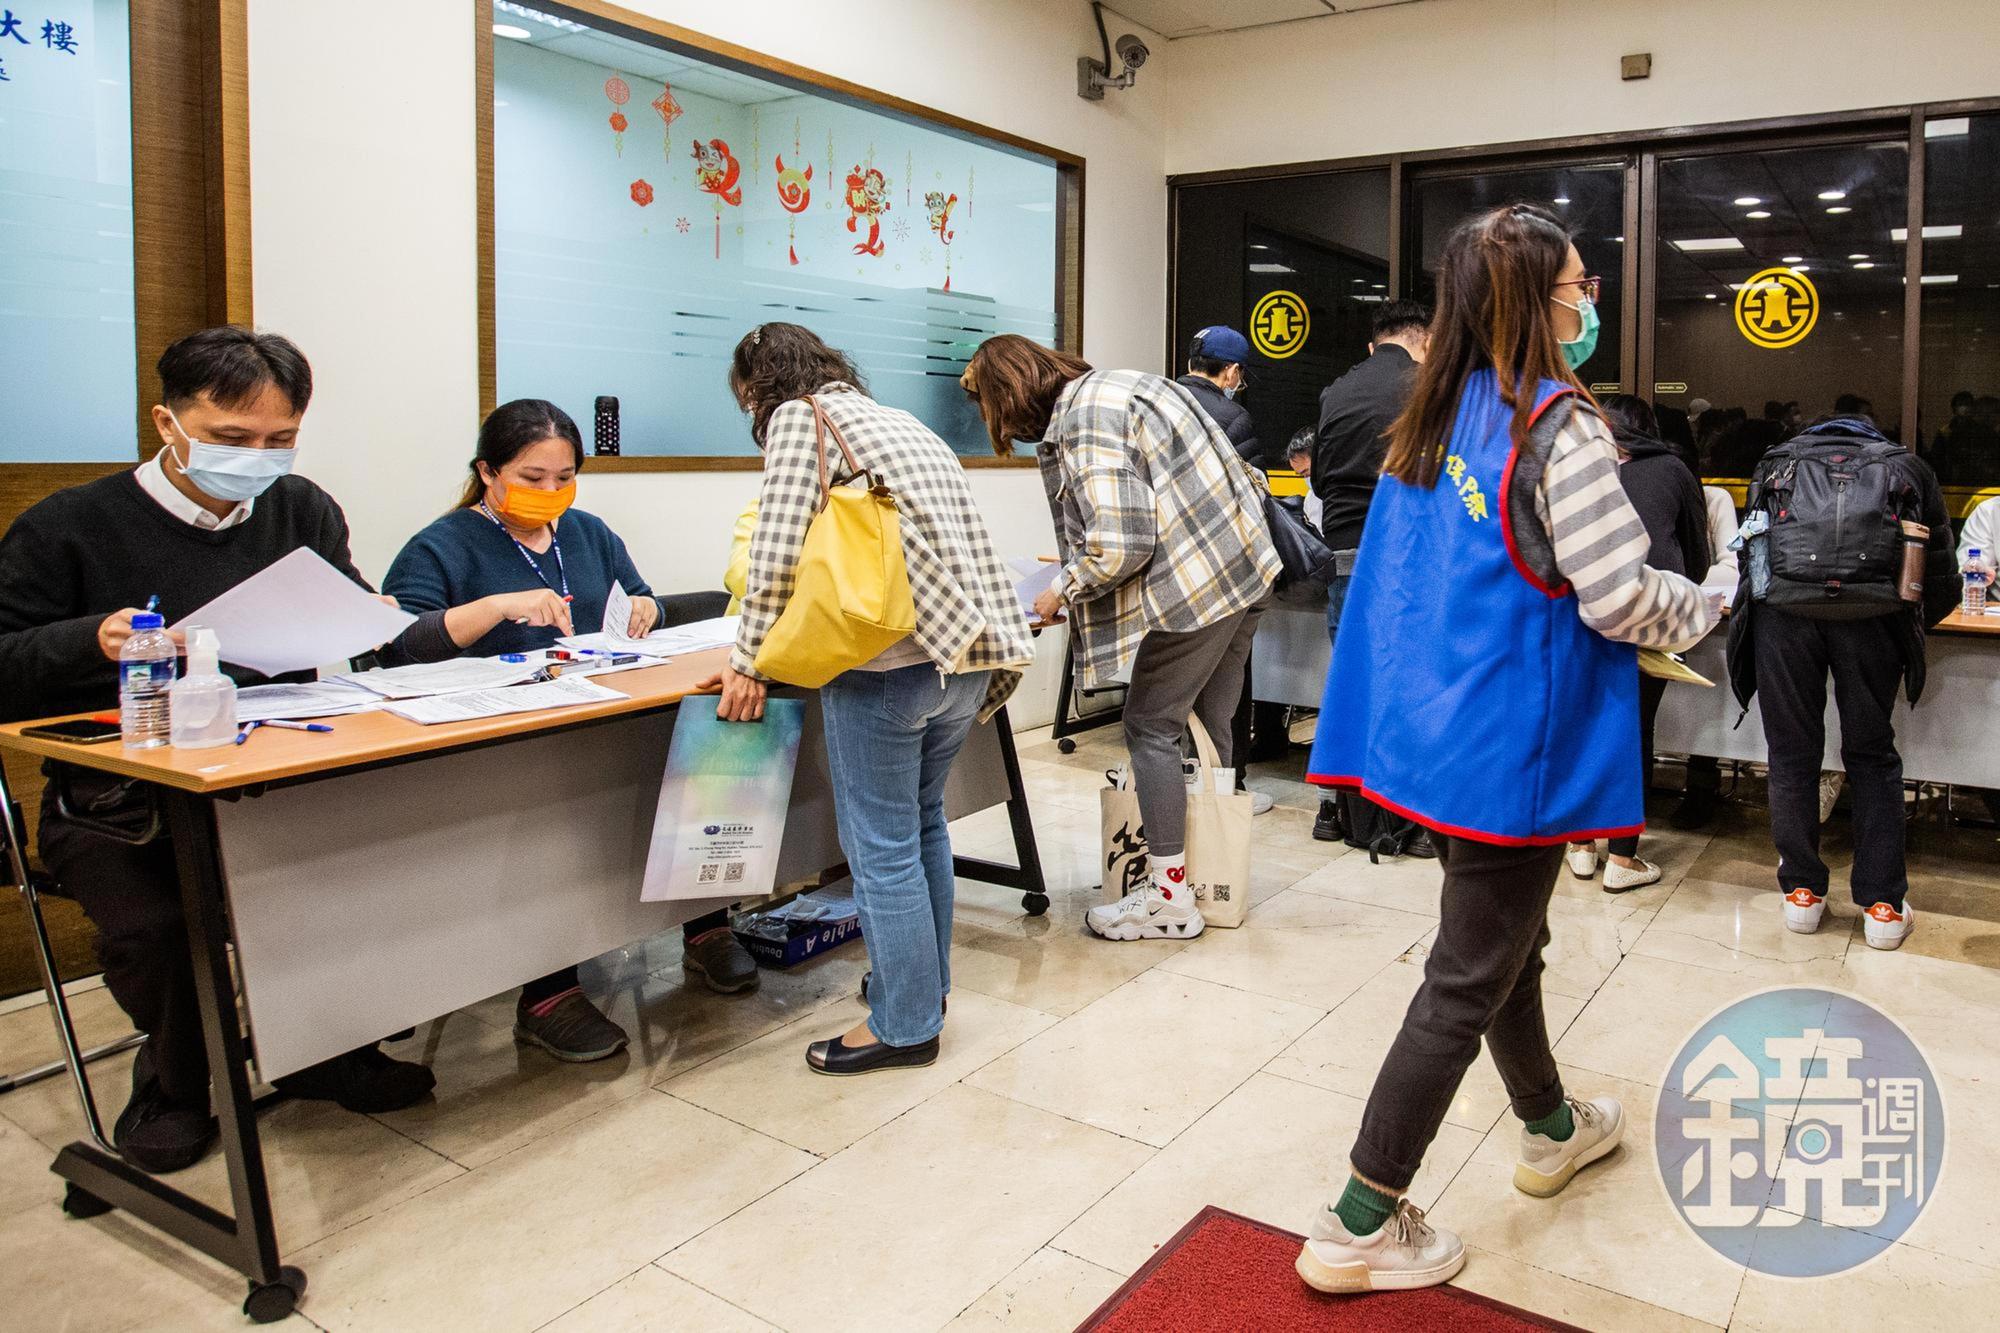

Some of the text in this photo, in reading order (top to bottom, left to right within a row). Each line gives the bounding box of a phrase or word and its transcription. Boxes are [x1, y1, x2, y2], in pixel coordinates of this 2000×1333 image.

[0, 10, 79, 55] 大樓
[806, 917, 862, 954] ouble A
